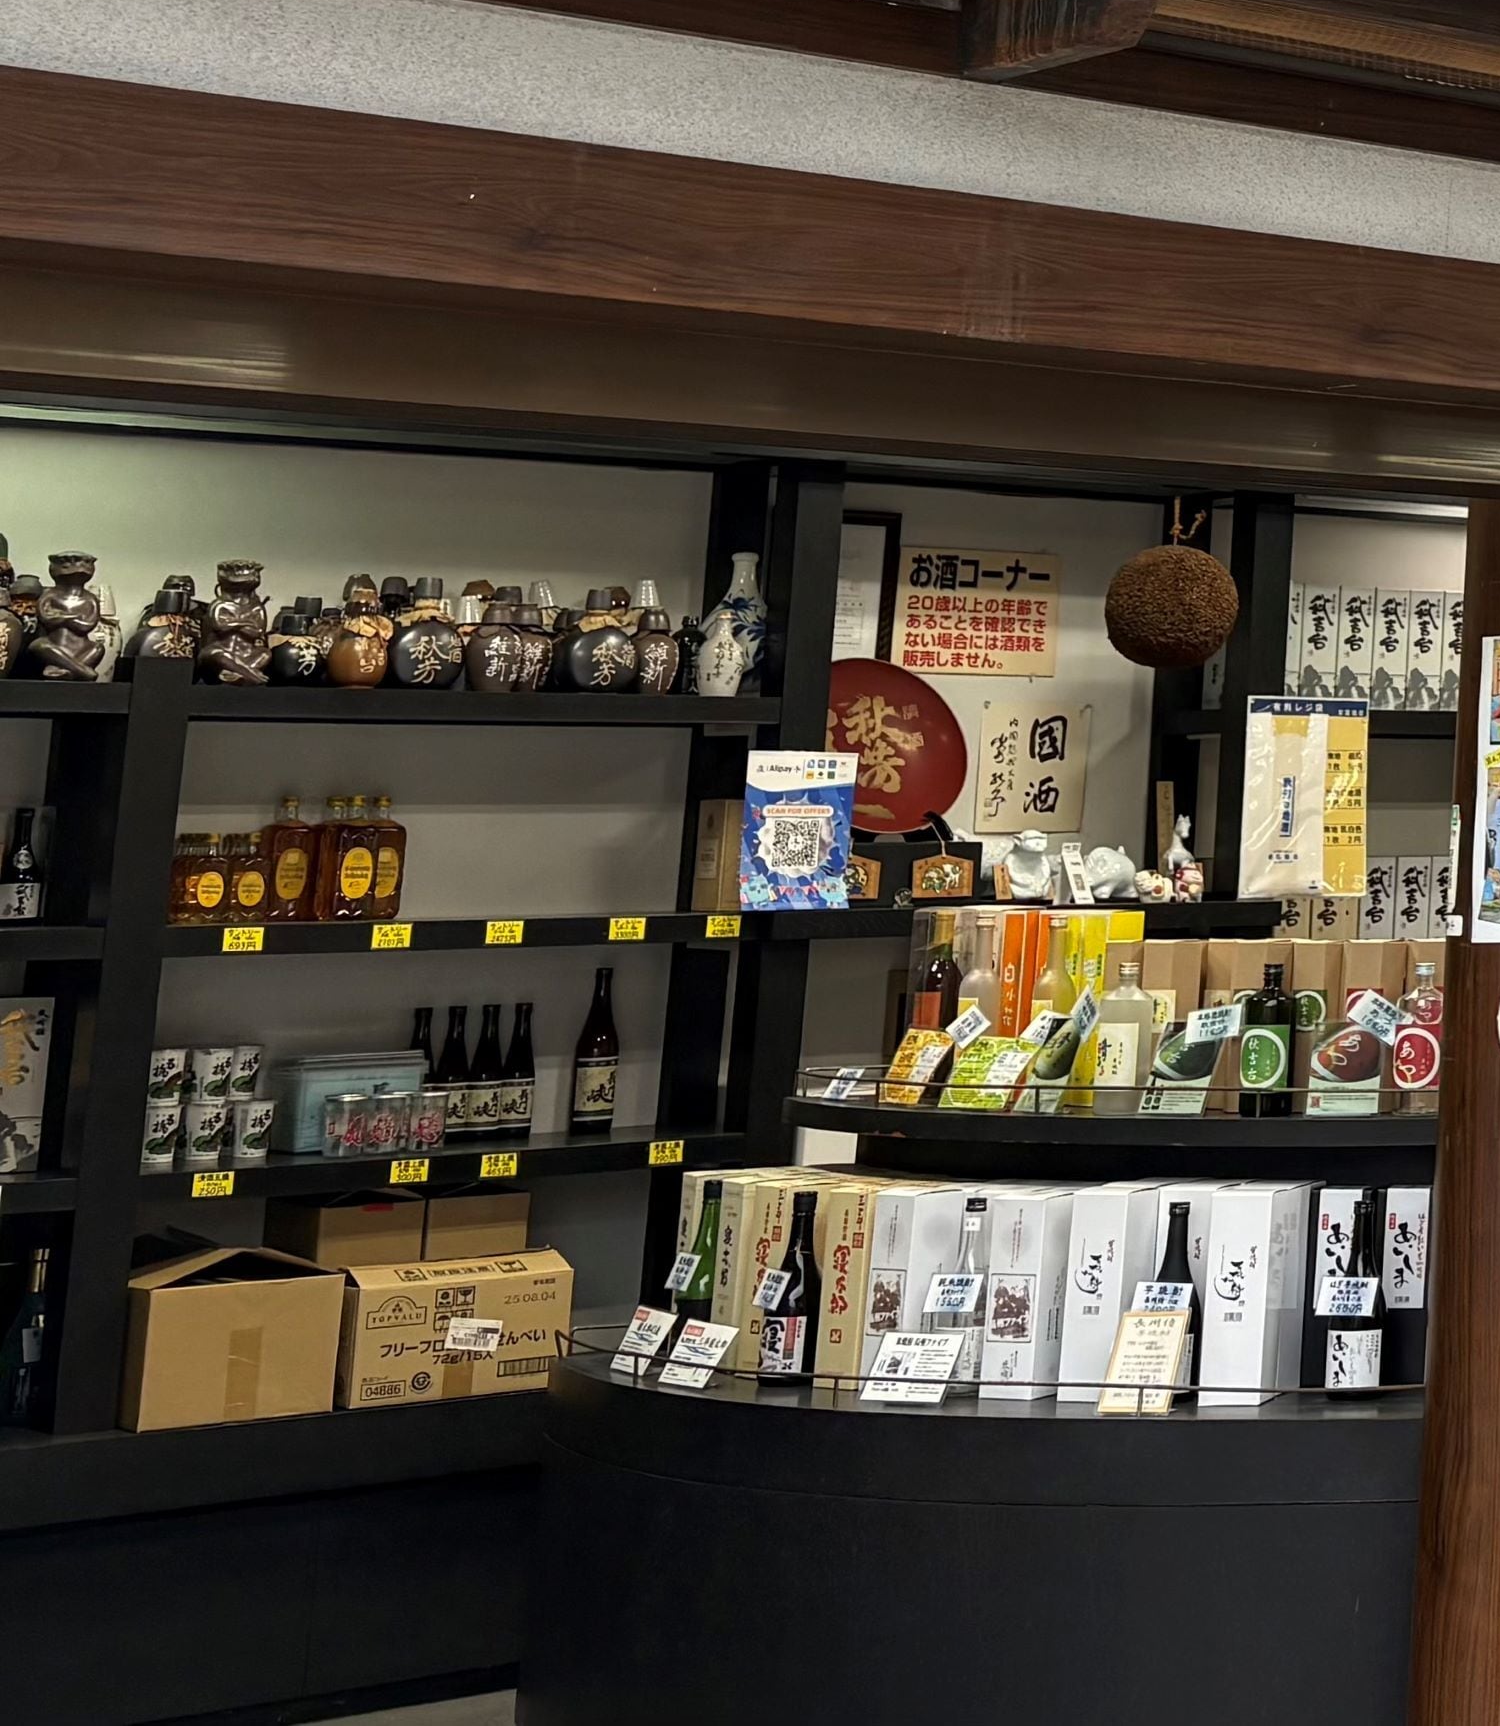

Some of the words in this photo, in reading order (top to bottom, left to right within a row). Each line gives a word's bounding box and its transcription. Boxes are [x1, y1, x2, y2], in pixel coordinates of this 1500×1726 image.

[909, 554, 1050, 591] お酒コーナー
[907, 595, 1048, 616] 20歳以上の年齢で
[906, 614, 1046, 634] あることを確認でき
[904, 632, 1045, 653] ない場合には酒類を
[410, 636, 448, 684] 秋芳
[902, 650, 1004, 670] 販売しません。
[1273, 702, 1324, 713] 有料レジ袋
[1393, 1221, 1417, 1290] あいしま
[372, 1312, 423, 1324] TOPVALU
[433, 1353, 494, 1365] 72g/15入
[365, 1385, 402, 1398] 04886
